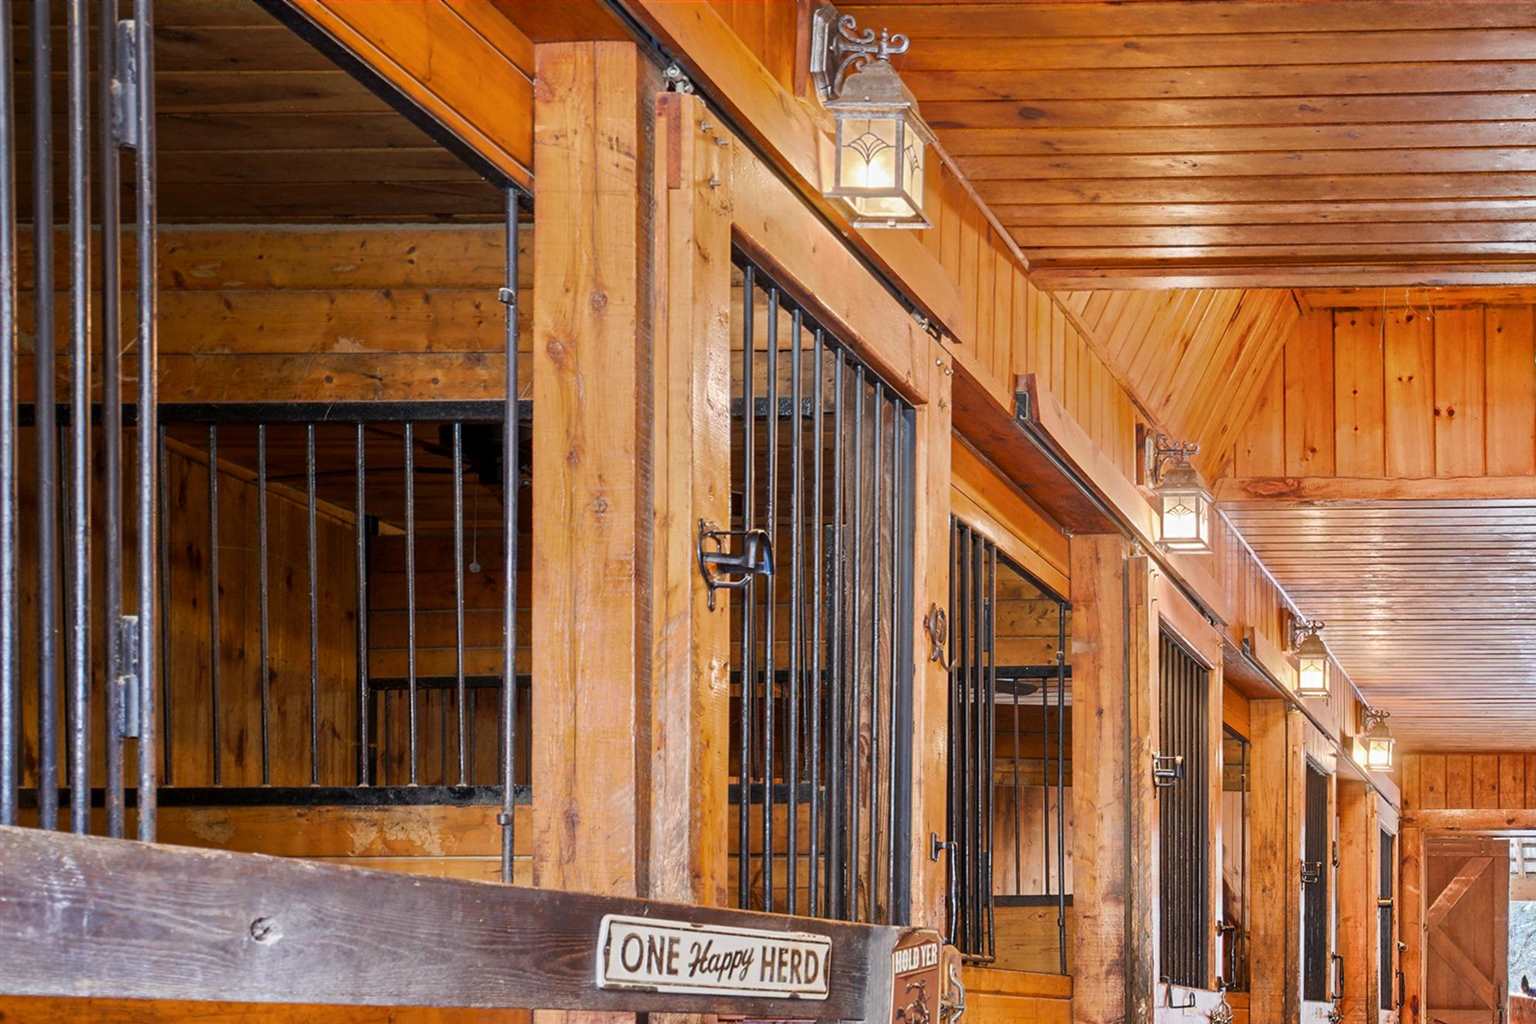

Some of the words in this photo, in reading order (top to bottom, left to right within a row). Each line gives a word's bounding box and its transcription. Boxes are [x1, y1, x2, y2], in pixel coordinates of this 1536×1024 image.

[620, 932, 681, 977] ONE
[688, 939, 755, 983] Happy
[760, 945, 820, 985] HERD
[895, 946, 919, 974] HOLD
[920, 943, 938, 967] YER
